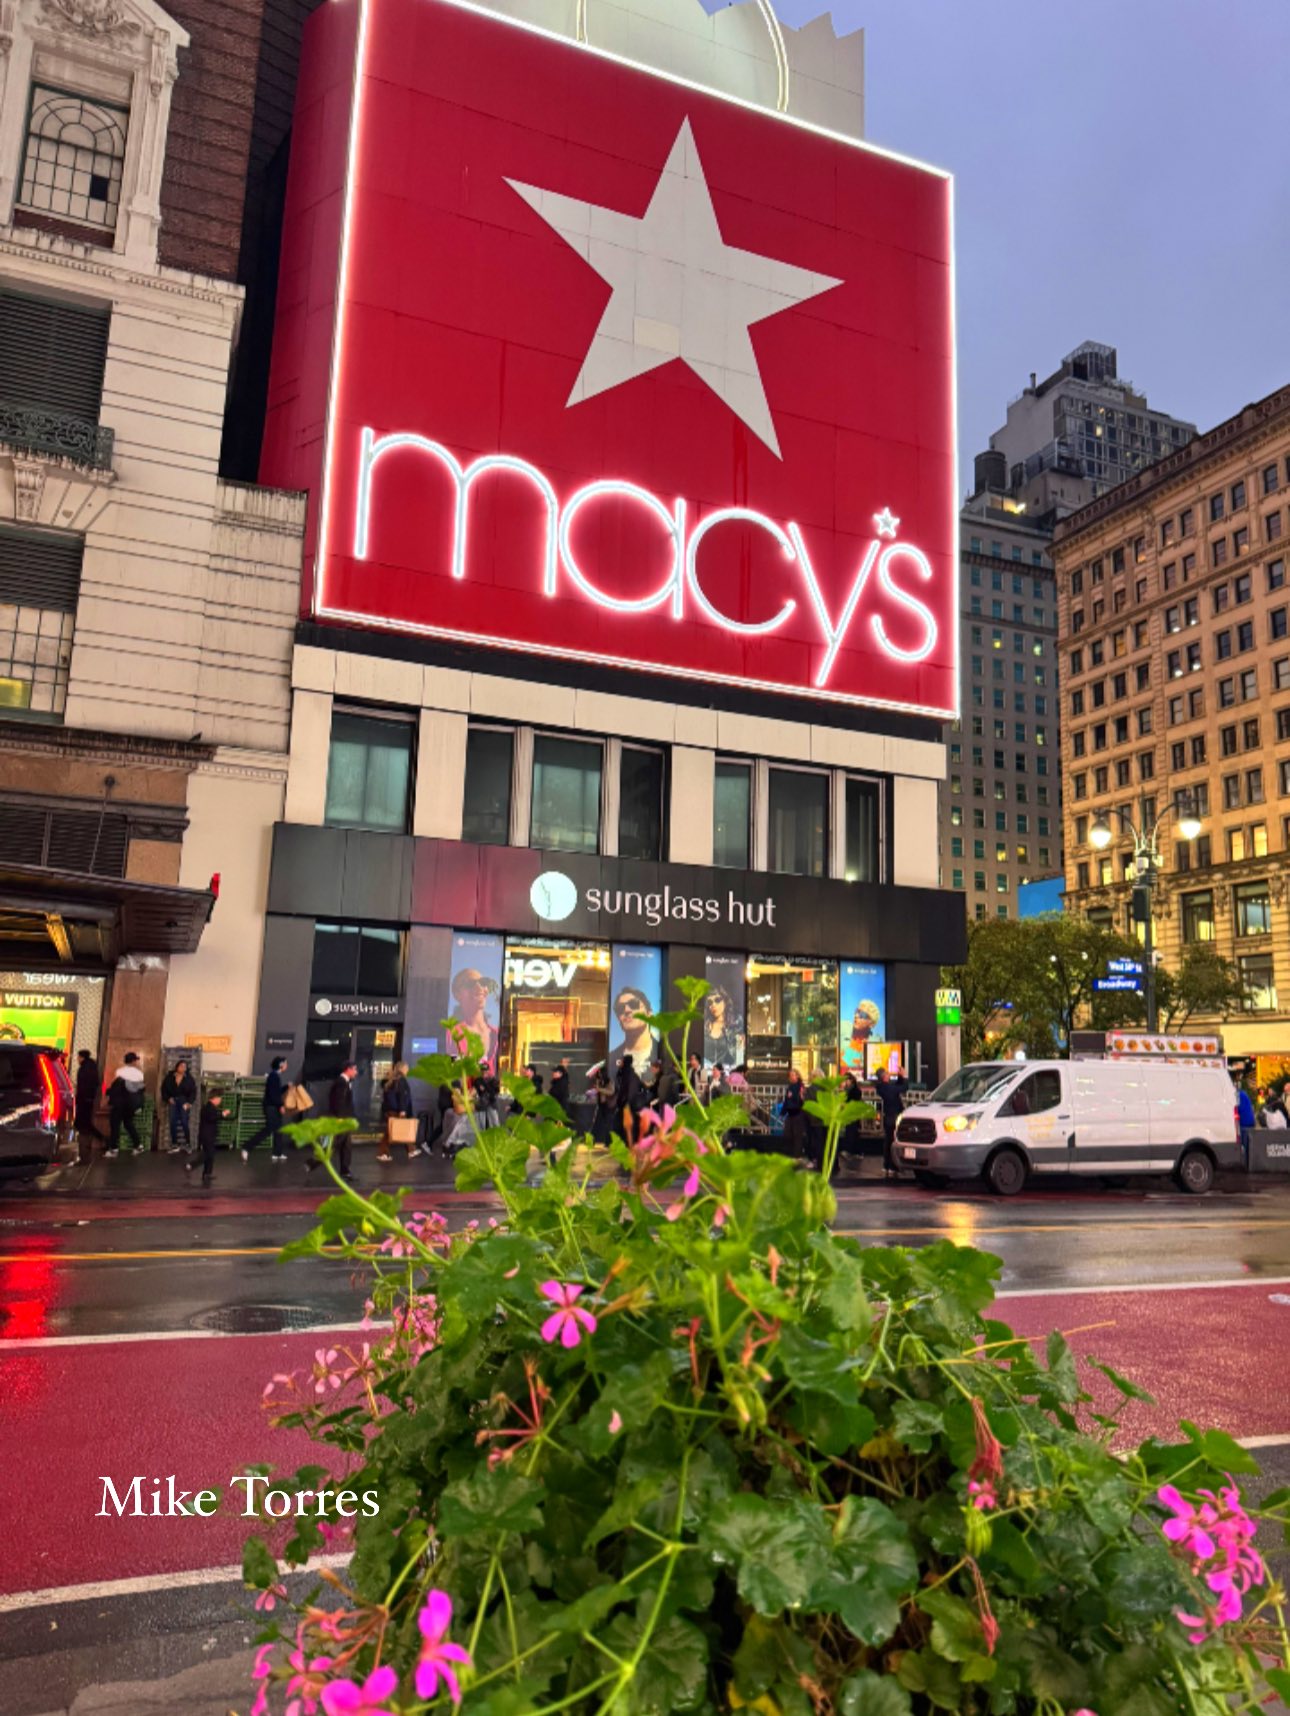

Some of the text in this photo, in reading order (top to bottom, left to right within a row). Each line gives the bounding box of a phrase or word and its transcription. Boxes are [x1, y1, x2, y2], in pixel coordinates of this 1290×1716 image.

[586, 885, 777, 928] sunglass hut
[1098, 980, 1136, 990] Broadway
[4, 993, 65, 1008] VUITTON
[333, 1002, 379, 1015] sunglass
